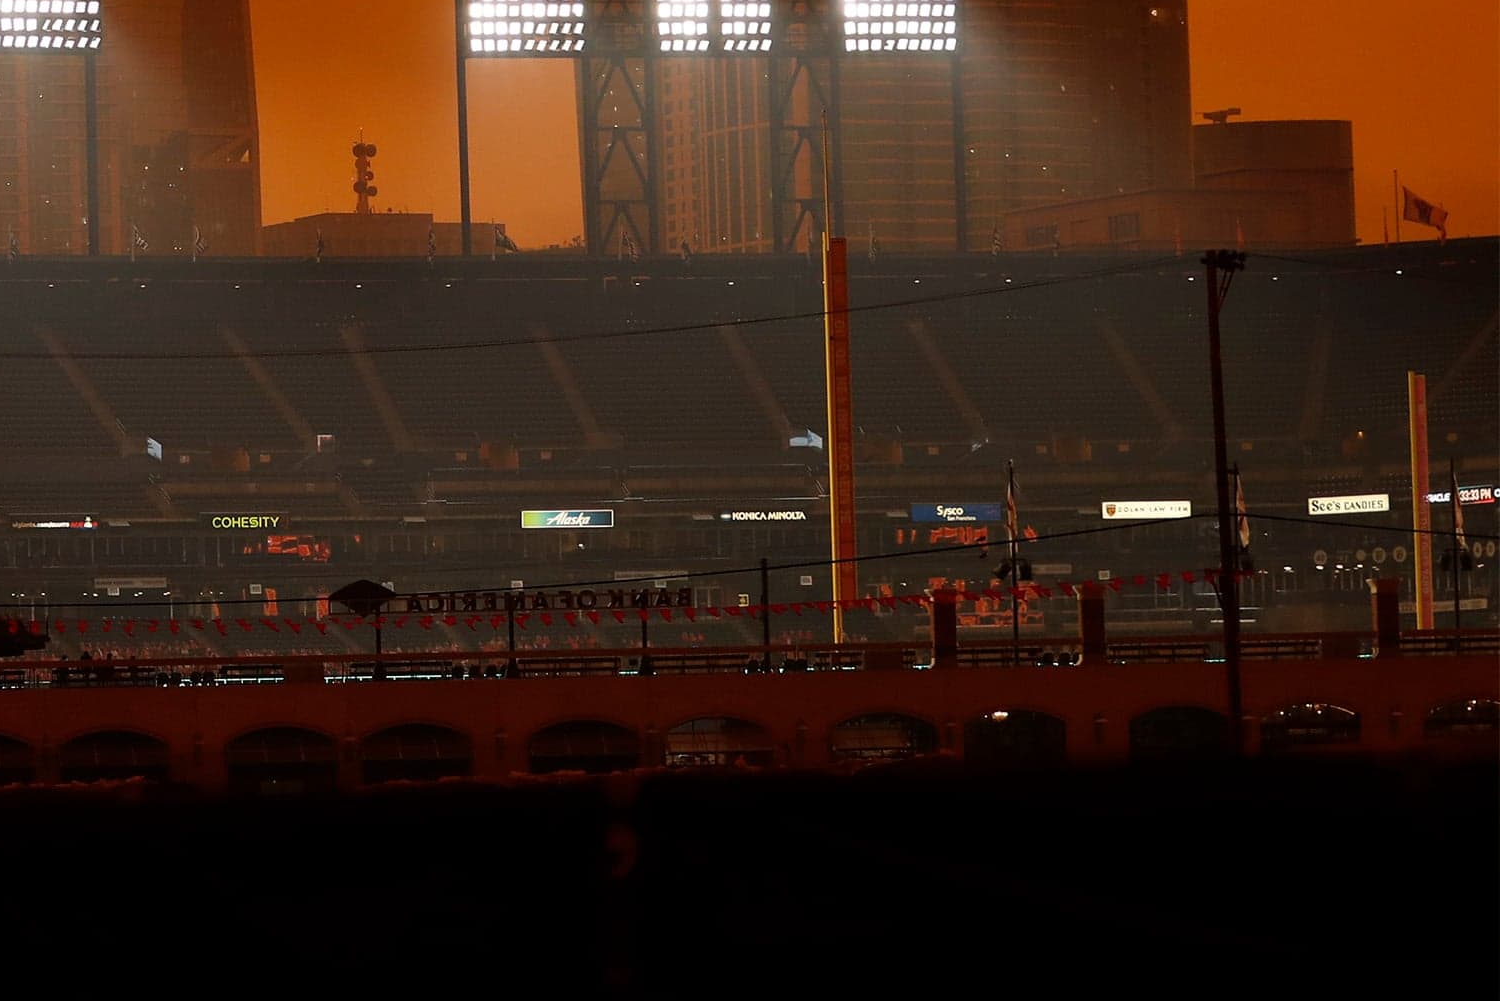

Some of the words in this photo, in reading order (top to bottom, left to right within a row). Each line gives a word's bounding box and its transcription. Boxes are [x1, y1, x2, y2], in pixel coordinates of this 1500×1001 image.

[936, 505, 964, 518] Sysco
[1311, 499, 1341, 512] See's
[1344, 499, 1384, 511] CANDIES
[547, 511, 591, 527] Alaska
[732, 511, 766, 520] KONICA
[768, 511, 806, 520] MINOLTA
[211, 516, 280, 529] COHESITY
